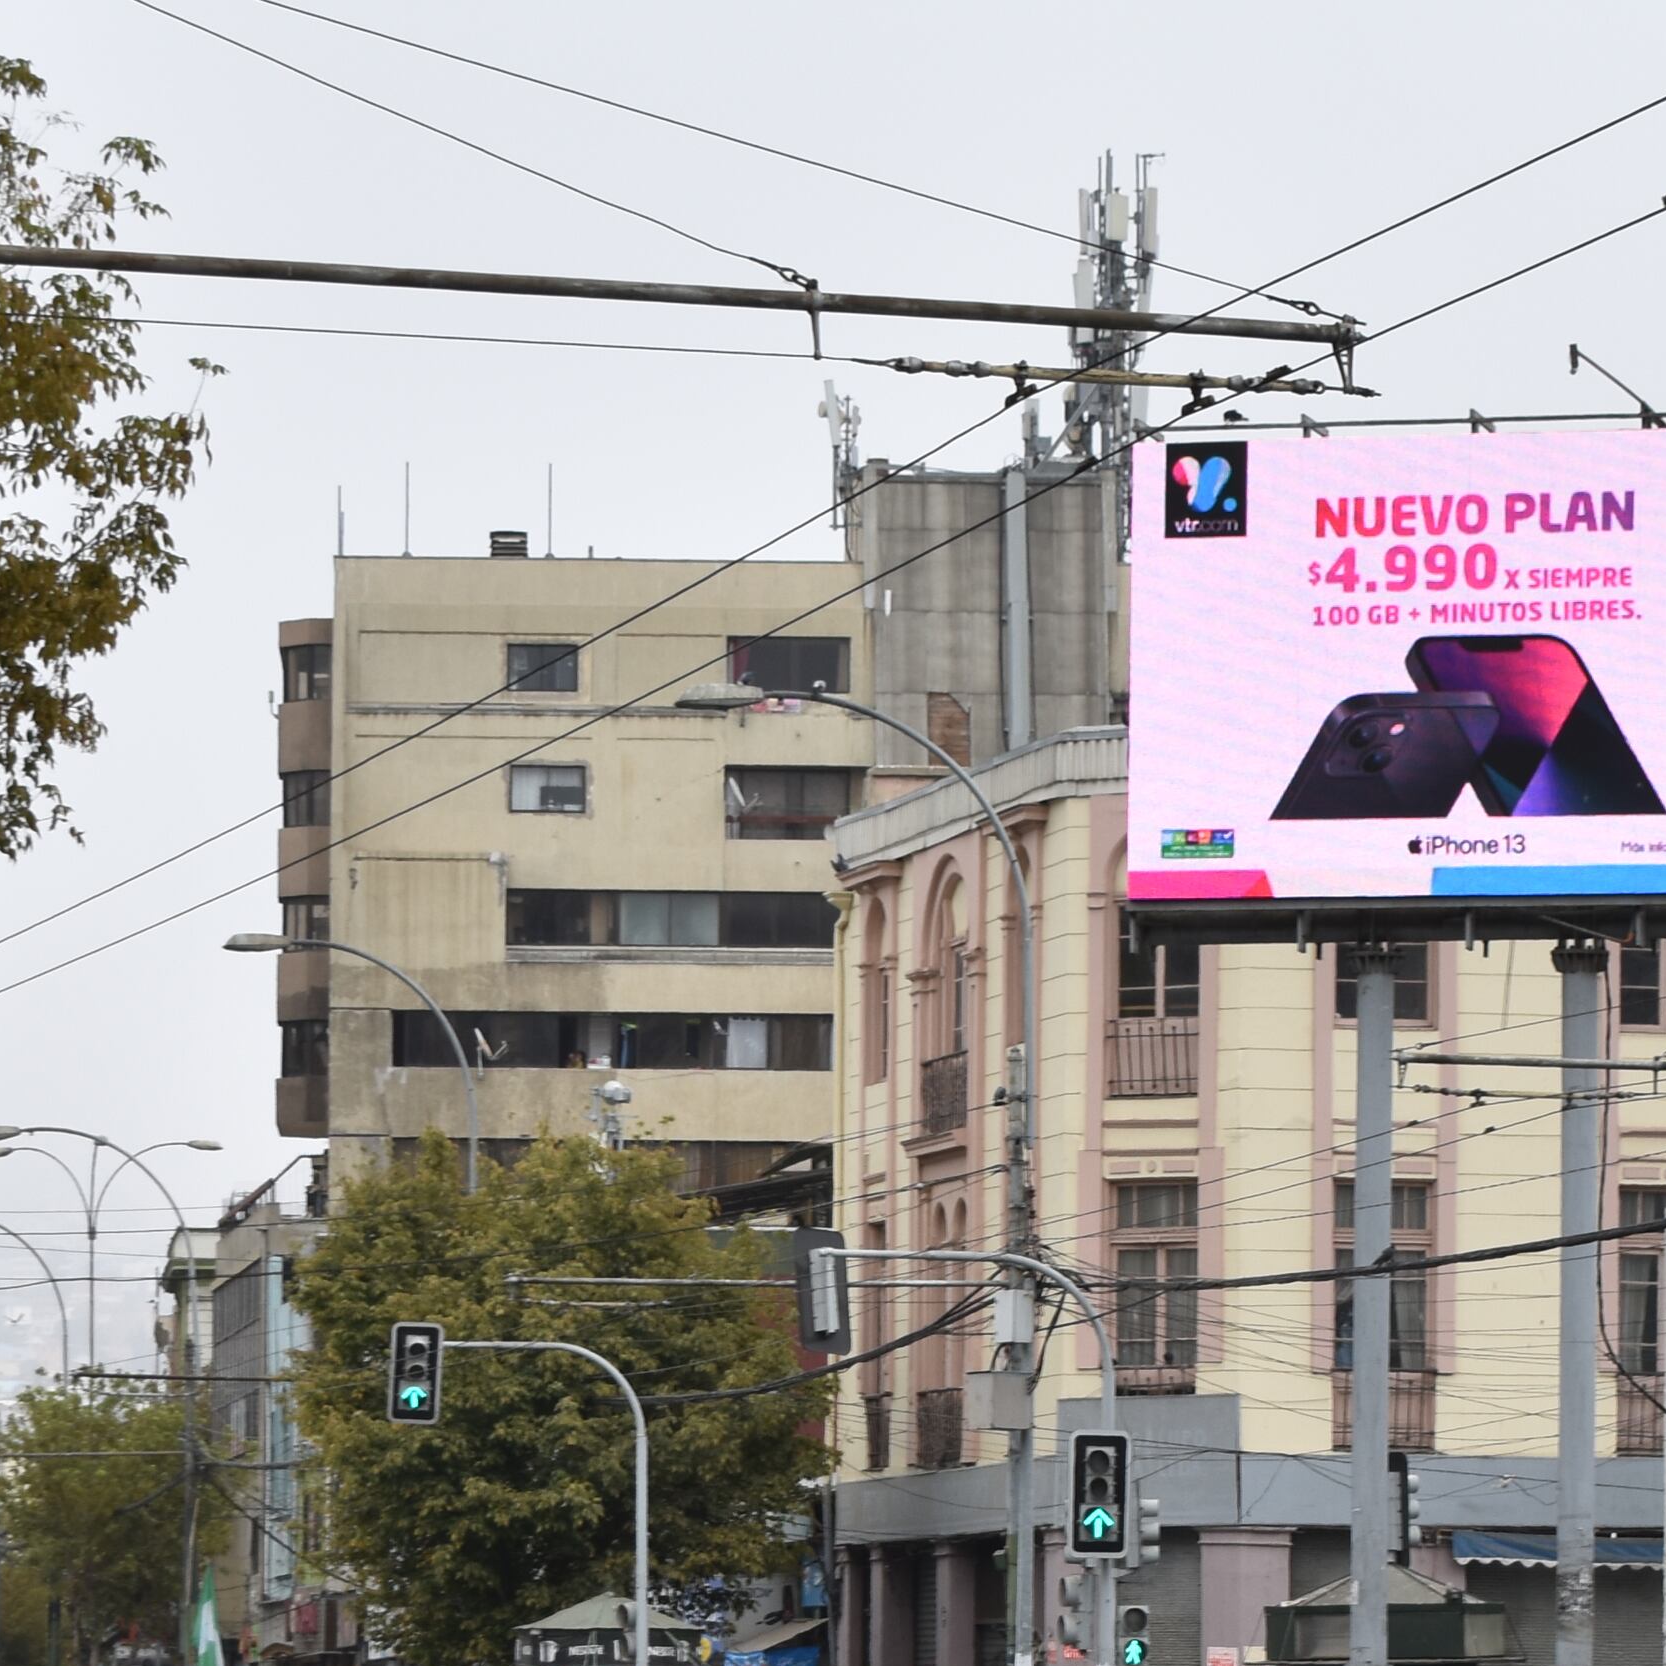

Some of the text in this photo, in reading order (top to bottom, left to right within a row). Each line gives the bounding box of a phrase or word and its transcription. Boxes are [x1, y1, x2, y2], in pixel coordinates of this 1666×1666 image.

[1315, 490, 1635, 538] NUEVO PLAN
[1308, 543, 1499, 593] $4.990
[1528, 567, 1633, 589] SIEMPRE
[1313, 605, 1360, 626] 100
[1368, 604, 1400, 625] GB
[1430, 602, 1543, 624] MINUTOS
[1550, 599, 1643, 621] LIBRES.
[1426, 834, 1526, 855] iPhone 13
